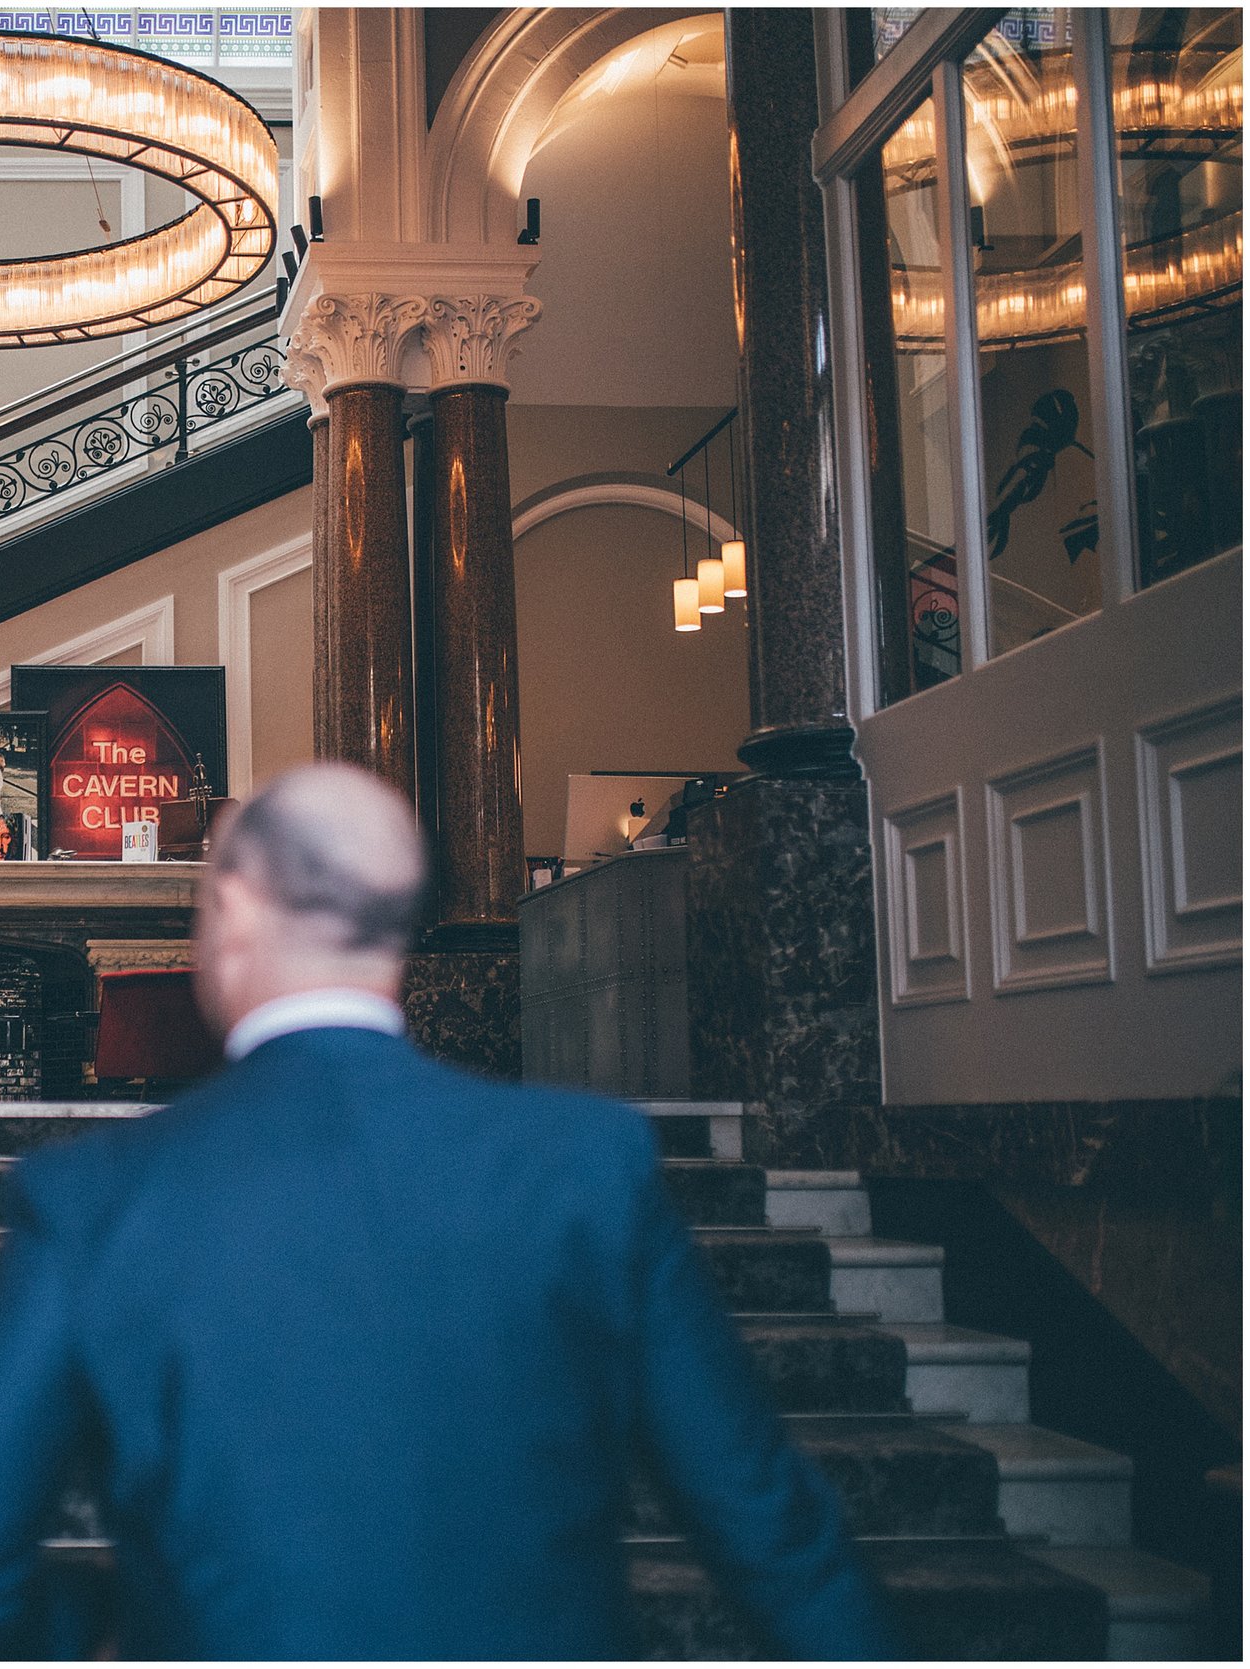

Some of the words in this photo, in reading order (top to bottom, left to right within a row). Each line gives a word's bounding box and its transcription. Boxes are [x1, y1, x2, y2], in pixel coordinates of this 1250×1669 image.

[92, 741, 146, 764] The
[62, 774, 179, 798] CAVERN
[124, 833, 150, 849] BEATLES
